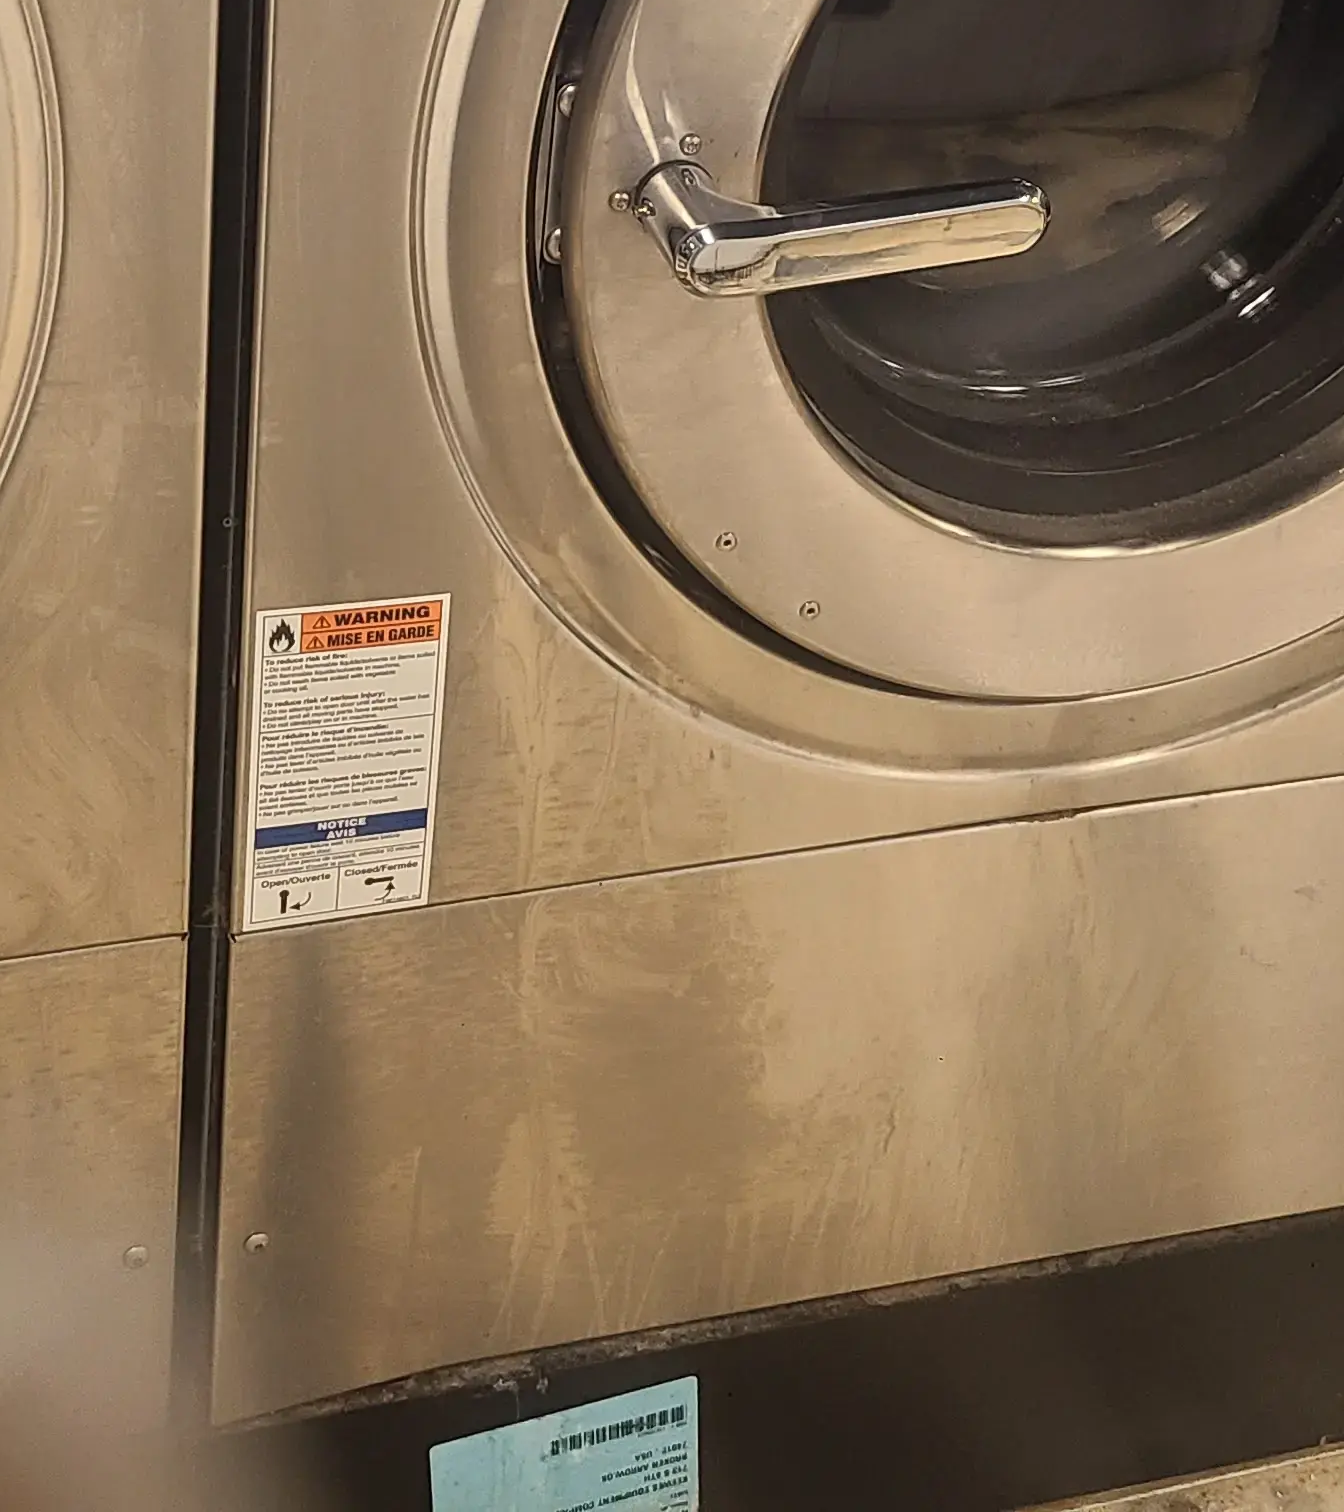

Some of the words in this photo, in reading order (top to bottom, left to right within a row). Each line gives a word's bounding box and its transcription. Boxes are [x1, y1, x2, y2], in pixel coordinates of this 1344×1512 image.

[334, 605, 430, 626] WARNING
[327, 632, 361, 646] MISE
[366, 629, 384, 643] EN
[388, 624, 434, 640] GARDE
[276, 656, 303, 664] reduce
[274, 699, 301, 707] reduce
[360, 690, 385, 699] injury:
[317, 817, 366, 831] NOTICE
[326, 827, 356, 839] AVIS
[344, 859, 418, 877] Closed/Fermée
[260, 871, 330, 889] Open/Ouverte
[634, 1449, 652, 1461] USA
